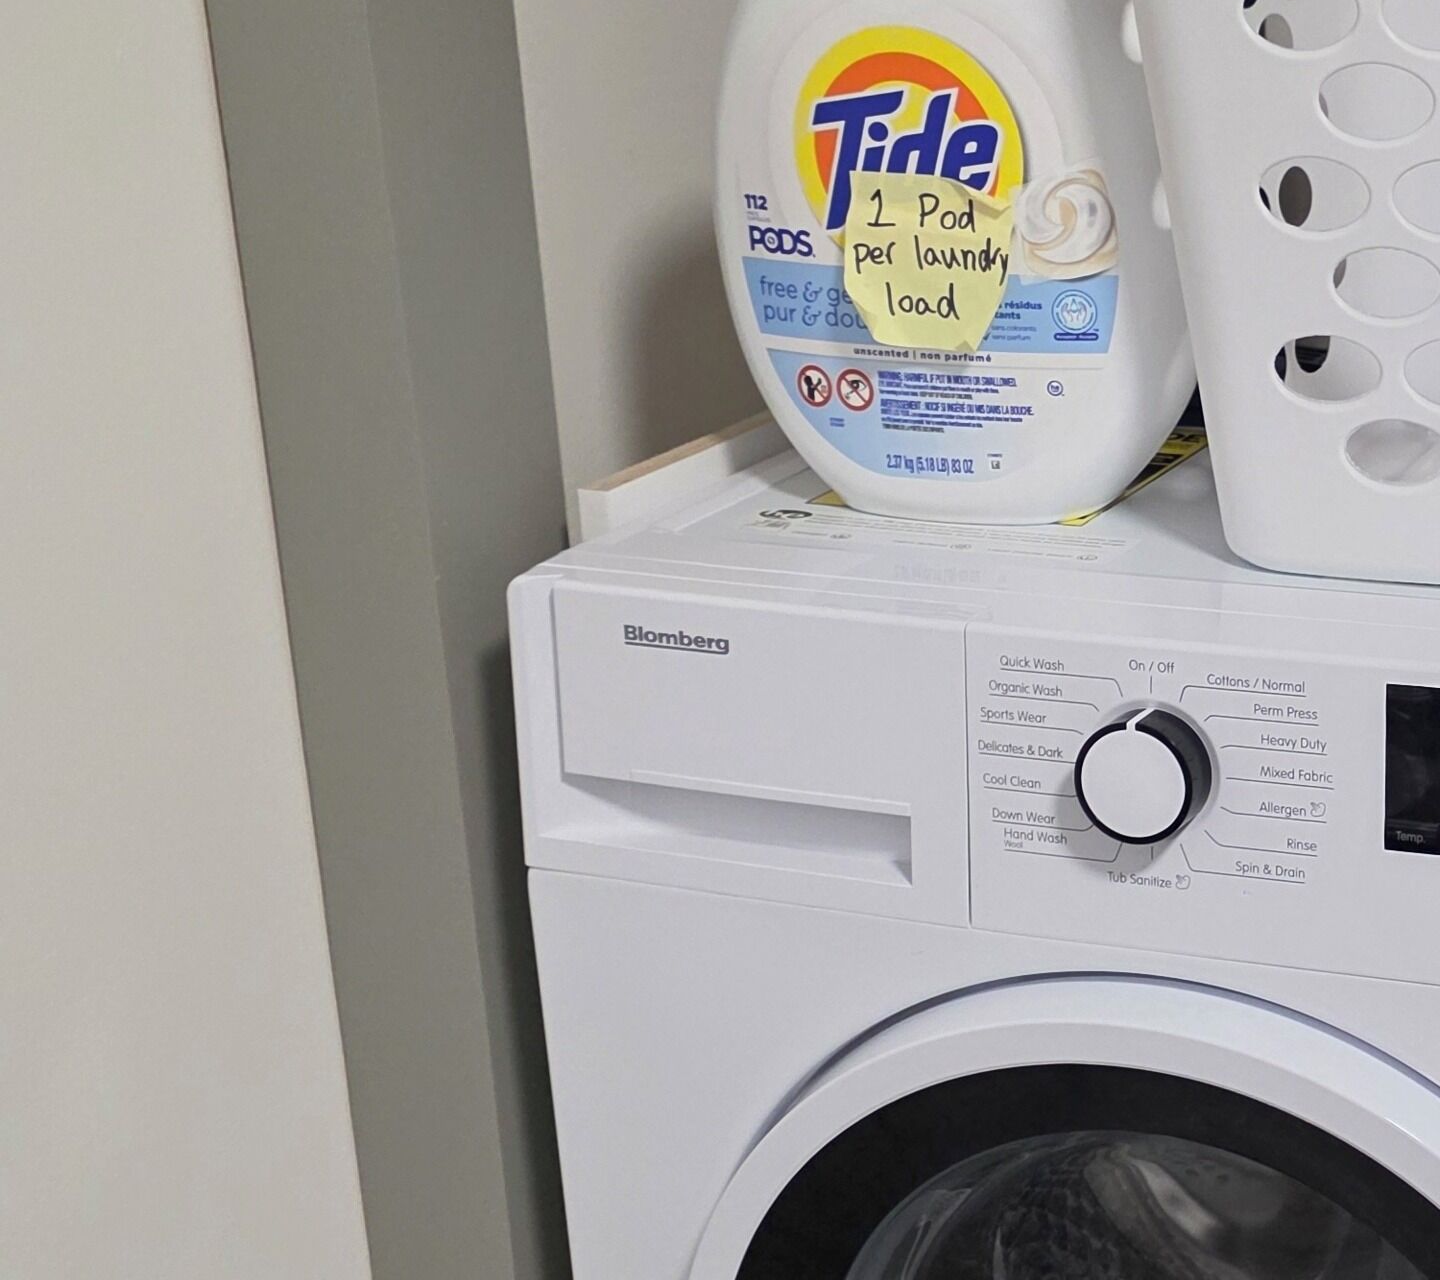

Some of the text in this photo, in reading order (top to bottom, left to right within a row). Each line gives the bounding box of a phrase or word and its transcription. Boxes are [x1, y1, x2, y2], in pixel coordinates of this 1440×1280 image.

[812, 90, 998, 230] Tide
[744, 194, 768, 210] 112
[867, 189, 976, 233] 1 Pod
[853, 235, 1009, 286] per laundry
[760, 276, 853, 307] free & ge
[886, 282, 960, 320] load
[764, 304, 867, 329] pur & dou
[994, 311, 1021, 320] tants
[853, 348, 909, 358] unscented
[920, 352, 991, 363] non parfumé
[624, 624, 729, 655] Blomberg
[1000, 655, 1065, 671] Quick Wash
[1128, 660, 1145, 671] On
[1157, 661, 1175, 673] Off
[988, 680, 1063, 697] Organic Wash
[1206, 673, 1250, 689] Cottons
[1261, 679, 1306, 694] Normal
[980, 707, 1046, 724] Sports Wear
[1253, 703, 1318, 720] Perm Press
[977, 740, 1063, 759] Delicates & Dark
[1260, 734, 1327, 753] Heavy Duty
[983, 773, 1041, 789] Cool Clean
[1260, 766, 1334, 784] Mixed Fabric
[992, 807, 1056, 825] Down Wear
[1259, 801, 1307, 818] Allergen
[1003, 828, 1068, 845] Hand Wash
[1286, 839, 1317, 852] Rinse
[1235, 861, 1305, 879] Spin & Drain
[1106, 871, 1172, 889] Tub Sanitize
